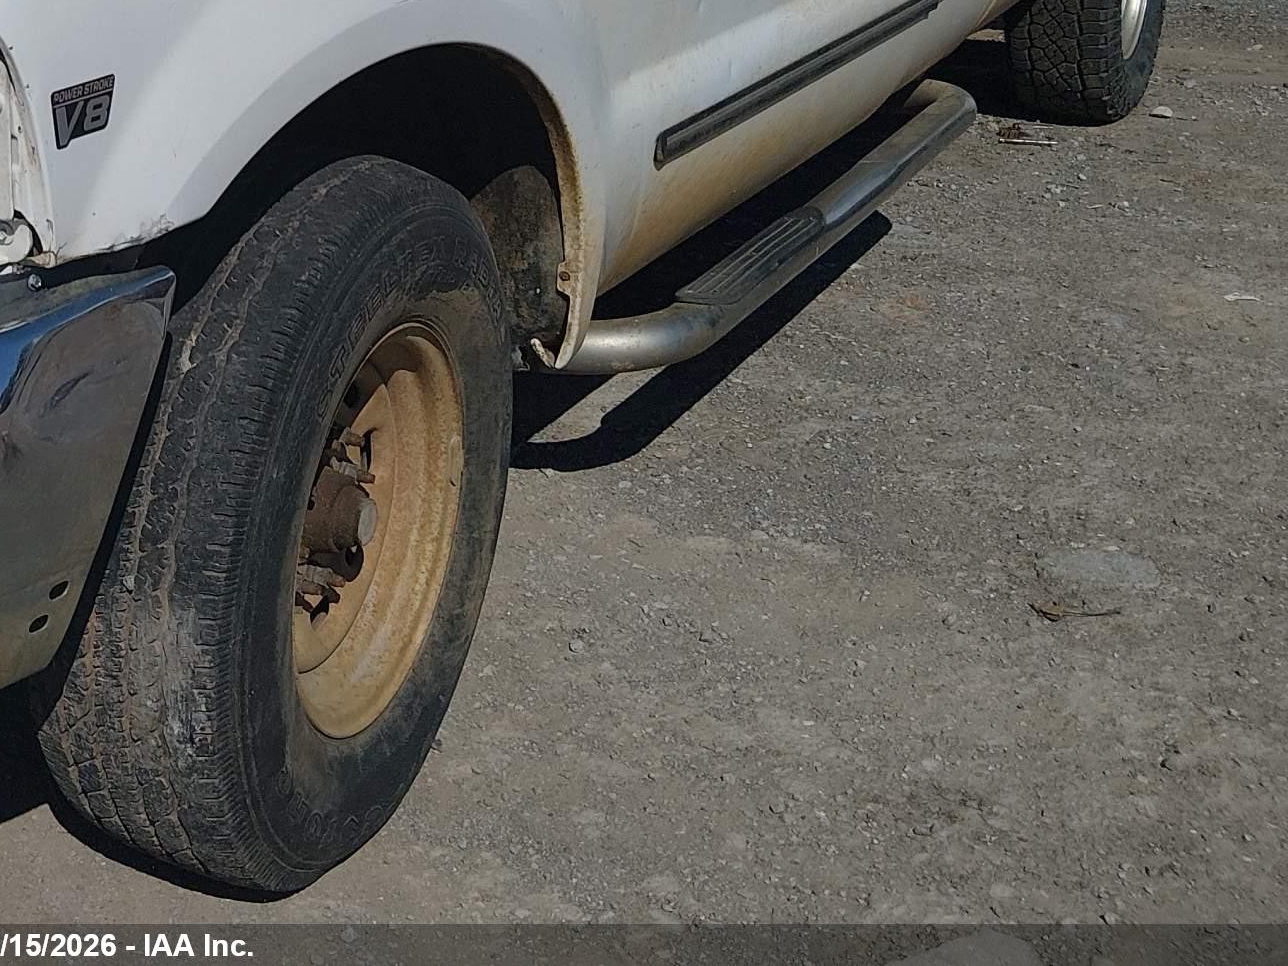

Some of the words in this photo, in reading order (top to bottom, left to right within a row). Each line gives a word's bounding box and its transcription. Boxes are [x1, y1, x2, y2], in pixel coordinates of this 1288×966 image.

[53, 85, 83, 104] POWER
[83, 76, 114, 95] STROKE
[55, 94, 110, 146] V8
